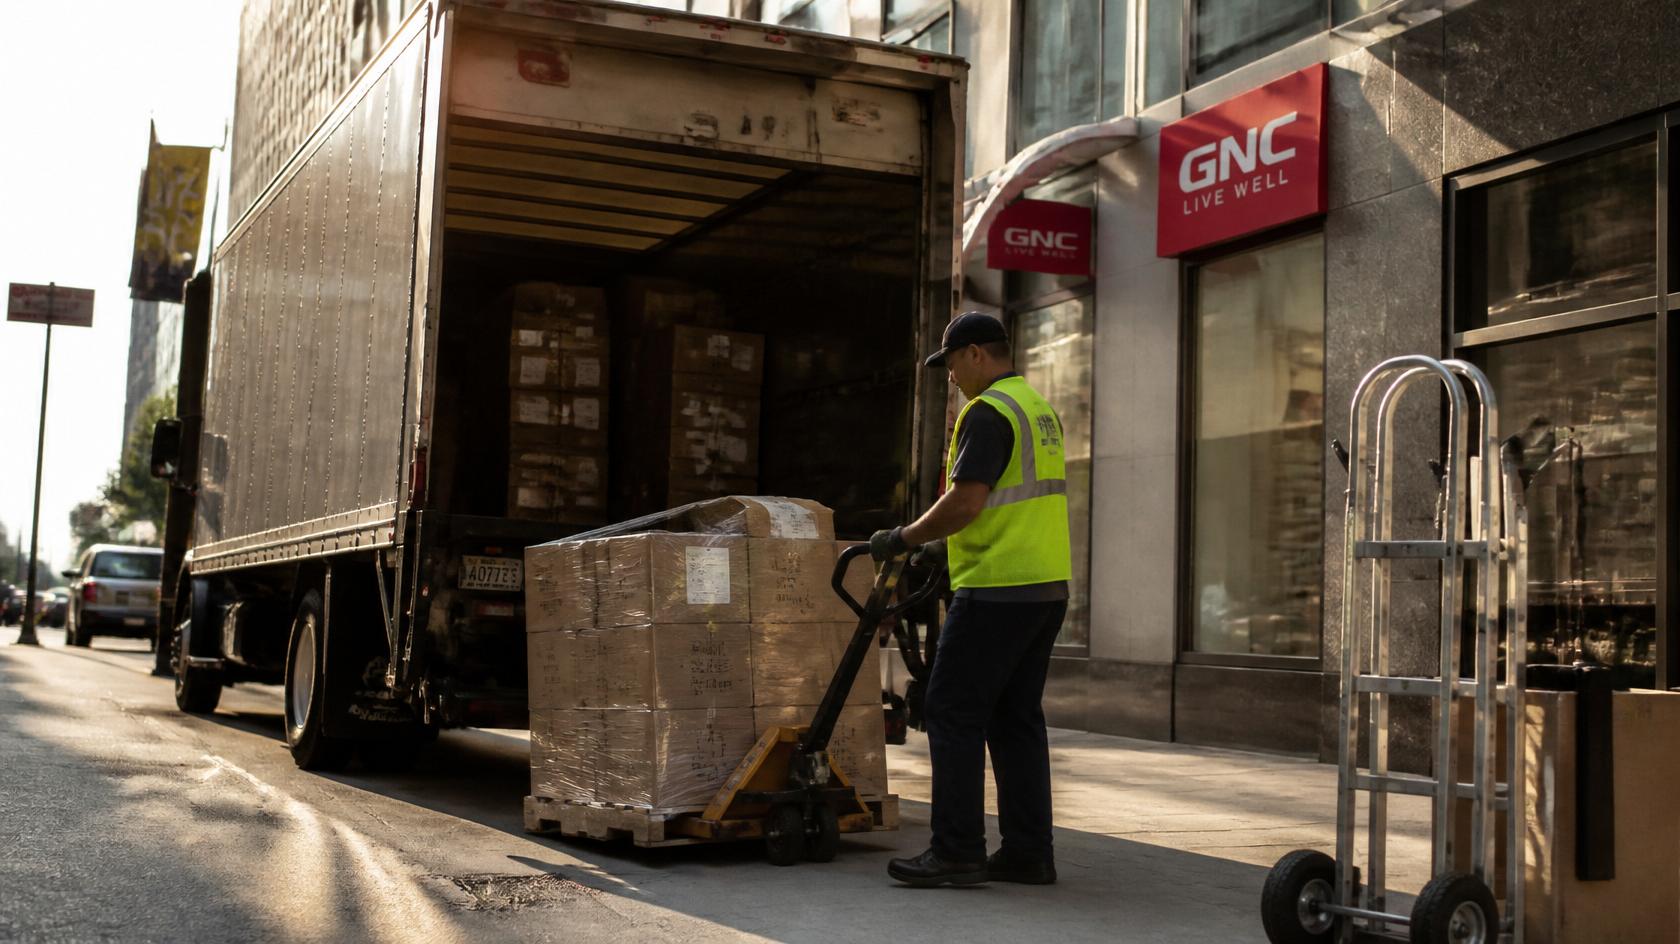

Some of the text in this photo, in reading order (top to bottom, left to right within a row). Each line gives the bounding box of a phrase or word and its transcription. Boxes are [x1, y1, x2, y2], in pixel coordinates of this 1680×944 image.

[1179, 111, 1297, 193] GNC
[1183, 168, 1289, 215] LIVE WELL
[1004, 227, 1079, 251] GNC
